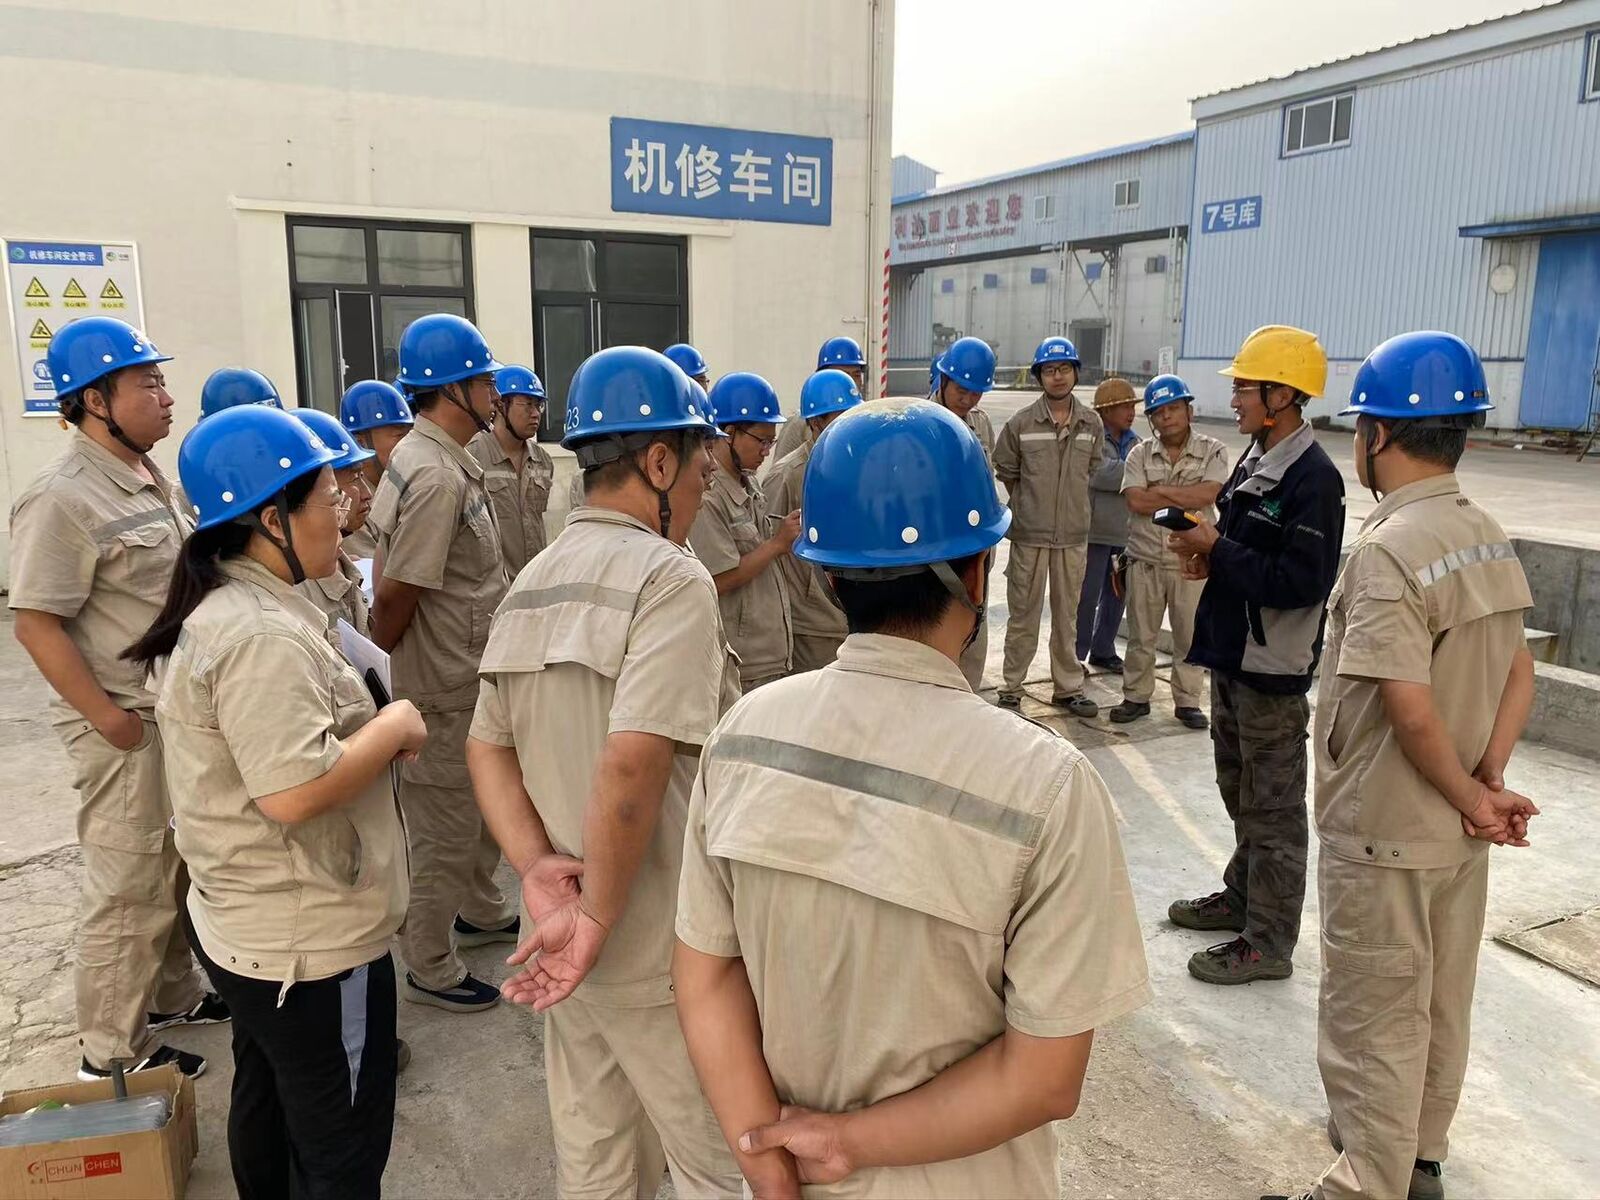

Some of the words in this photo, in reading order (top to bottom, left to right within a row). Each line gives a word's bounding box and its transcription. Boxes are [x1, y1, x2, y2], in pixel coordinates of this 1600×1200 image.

[624, 138, 821, 207] 机修车间
[1206, 200, 1257, 230] 7号库
[48, 1163, 82, 1176] CHUN
[86, 1159, 119, 1171] CHEN
